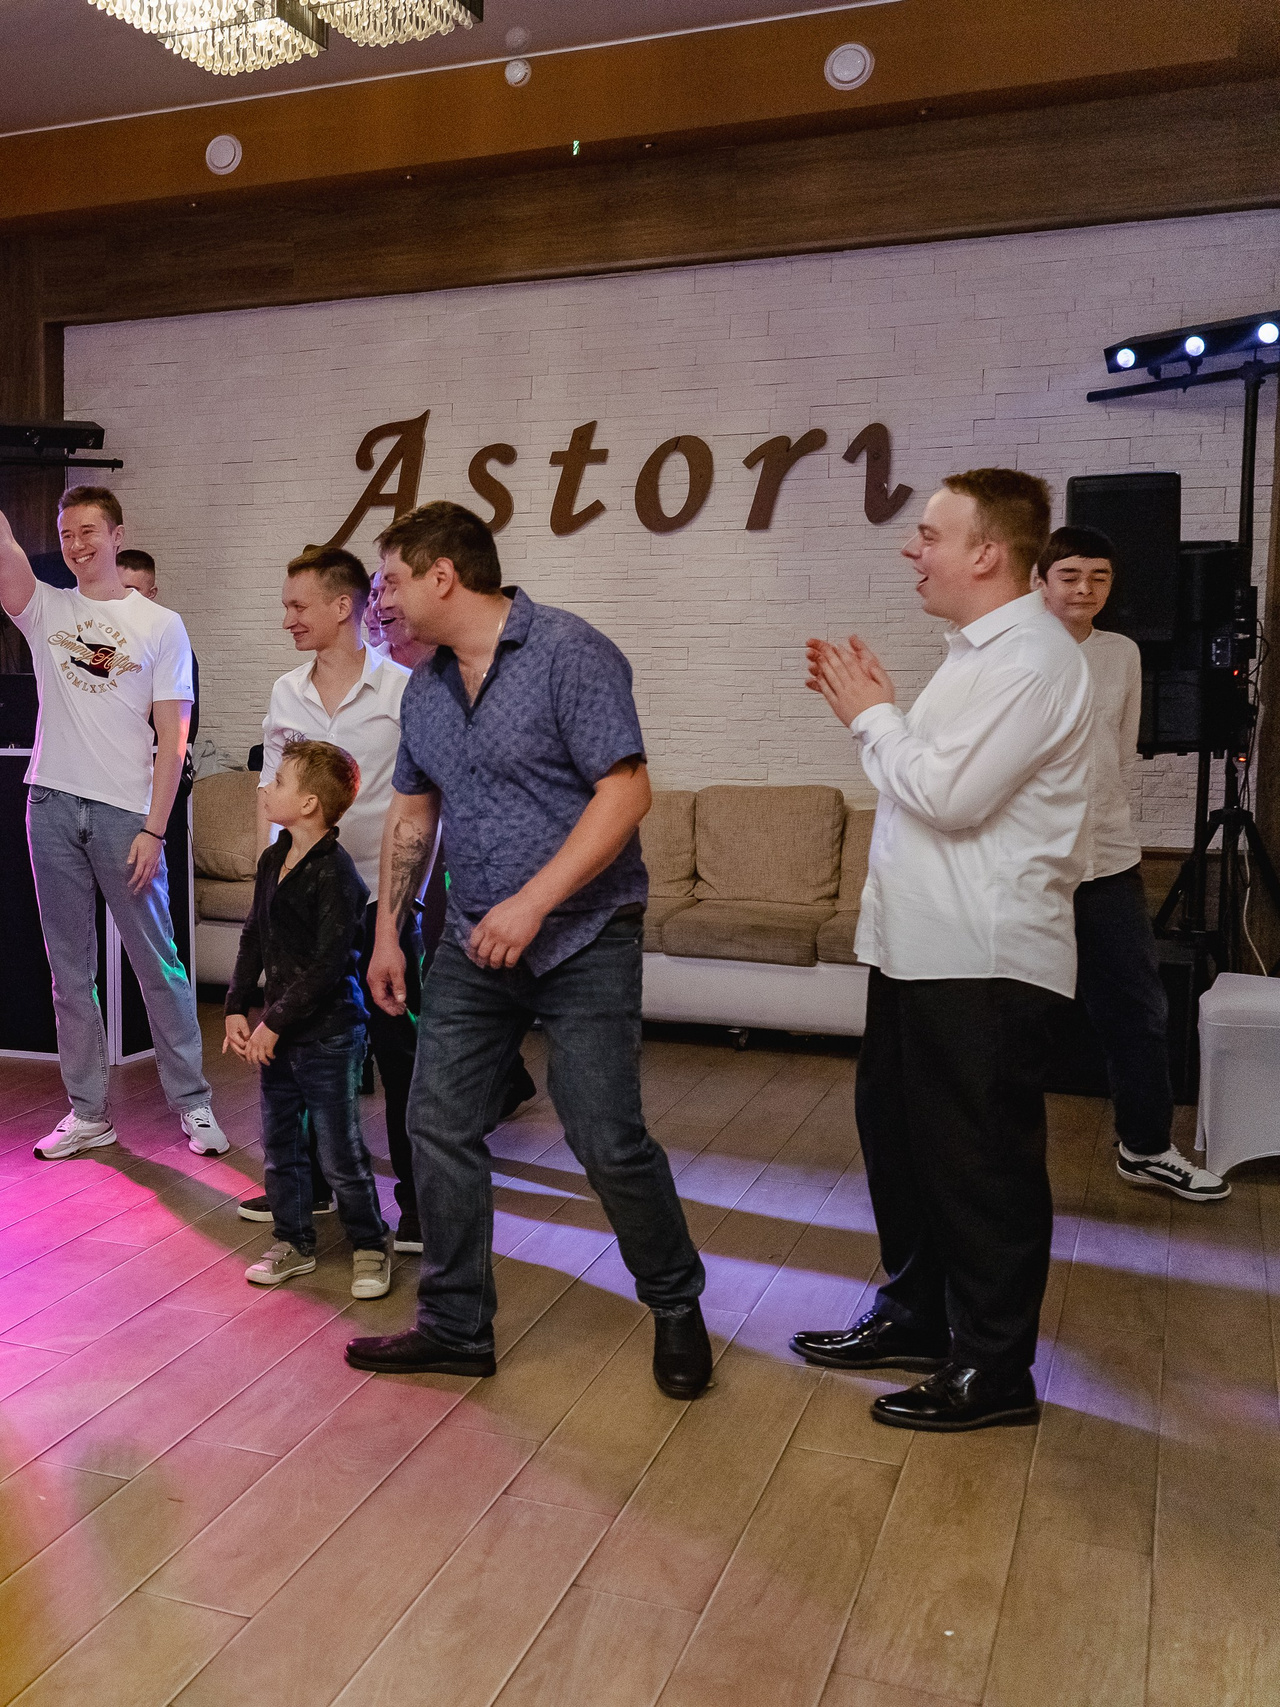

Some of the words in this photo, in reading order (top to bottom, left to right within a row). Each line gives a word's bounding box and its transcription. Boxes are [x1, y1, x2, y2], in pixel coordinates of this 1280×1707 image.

[76, 619, 94, 633] EW
[98, 622, 127, 647] YORK
[47, 630, 95, 661] Tommy
[90, 647, 142, 676] Hilfiger
